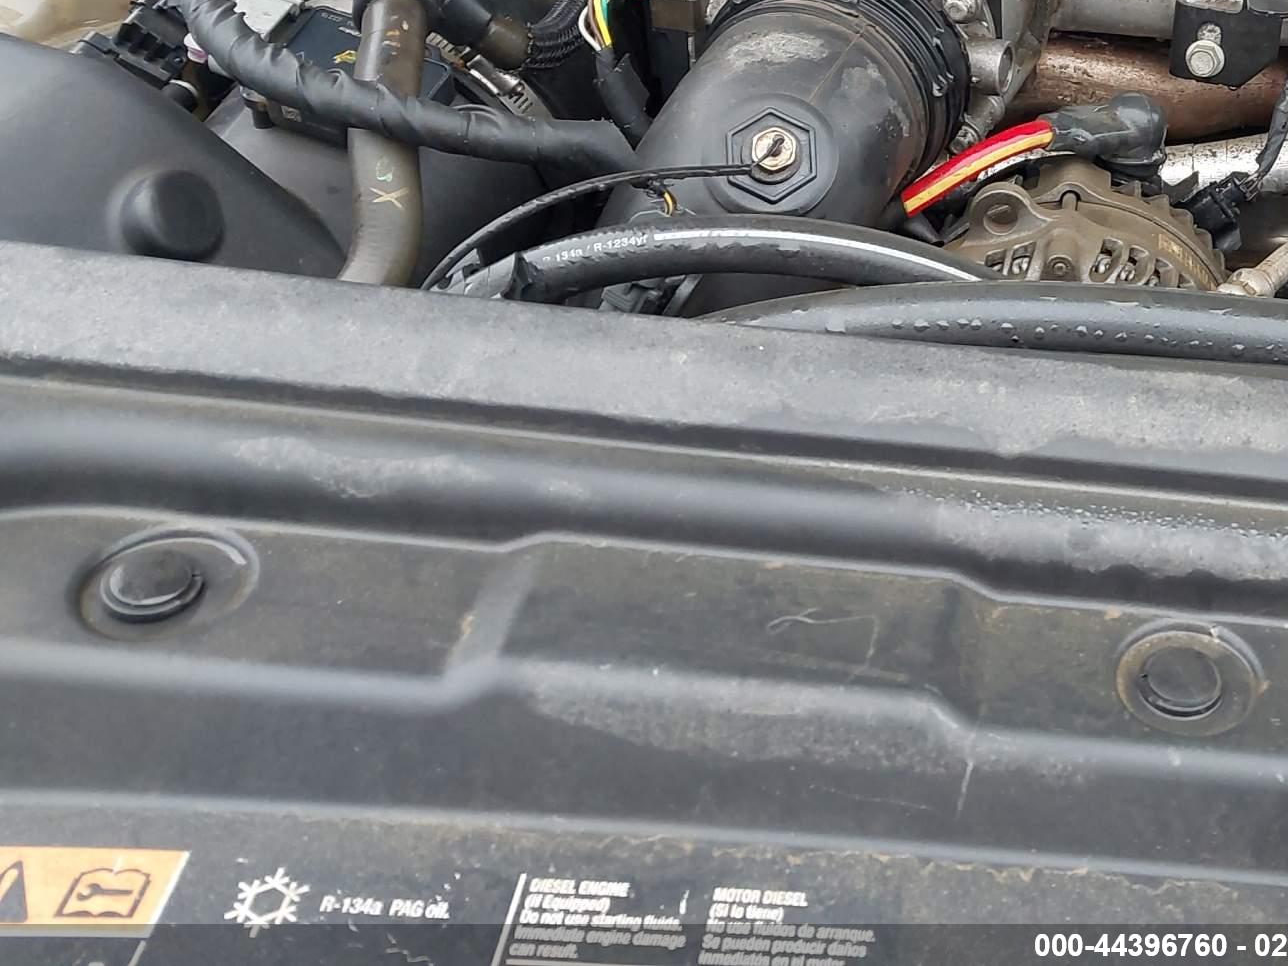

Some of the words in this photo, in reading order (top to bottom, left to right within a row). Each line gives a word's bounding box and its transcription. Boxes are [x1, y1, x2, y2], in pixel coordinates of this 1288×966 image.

[593, 234, 649, 252] R-1234yf
[529, 878, 577, 894] DIESEL
[578, 880, 631, 897] ENGINE
[713, 887, 761, 903] MOTOR
[762, 891, 808, 906] DIESEL
[319, 895, 384, 915] R-134a
[388, 898, 425, 918] PAG
[542, 895, 611, 914] Equipped)
[709, 903, 729, 918] (Si
[730, 904, 744, 918] lo
[745, 905, 784, 923] tiene)
[519, 909, 539, 924] Do
[540, 911, 564, 925] not
[564, 915, 590, 926] use
[589, 913, 642, 931] starting
[586, 930, 631, 946] engine
[632, 931, 686, 950] damage
[706, 919, 724, 933] No
[797, 923, 815, 938] de
[816, 927, 876, 942] arranque.
[509, 943, 536, 956] can
[536, 943, 578, 958] result.
[702, 934, 721, 949] Se
[721, 936, 771, 951] pueden
[771, 939, 826, 954] producir
[827, 941, 867, 957] daños
